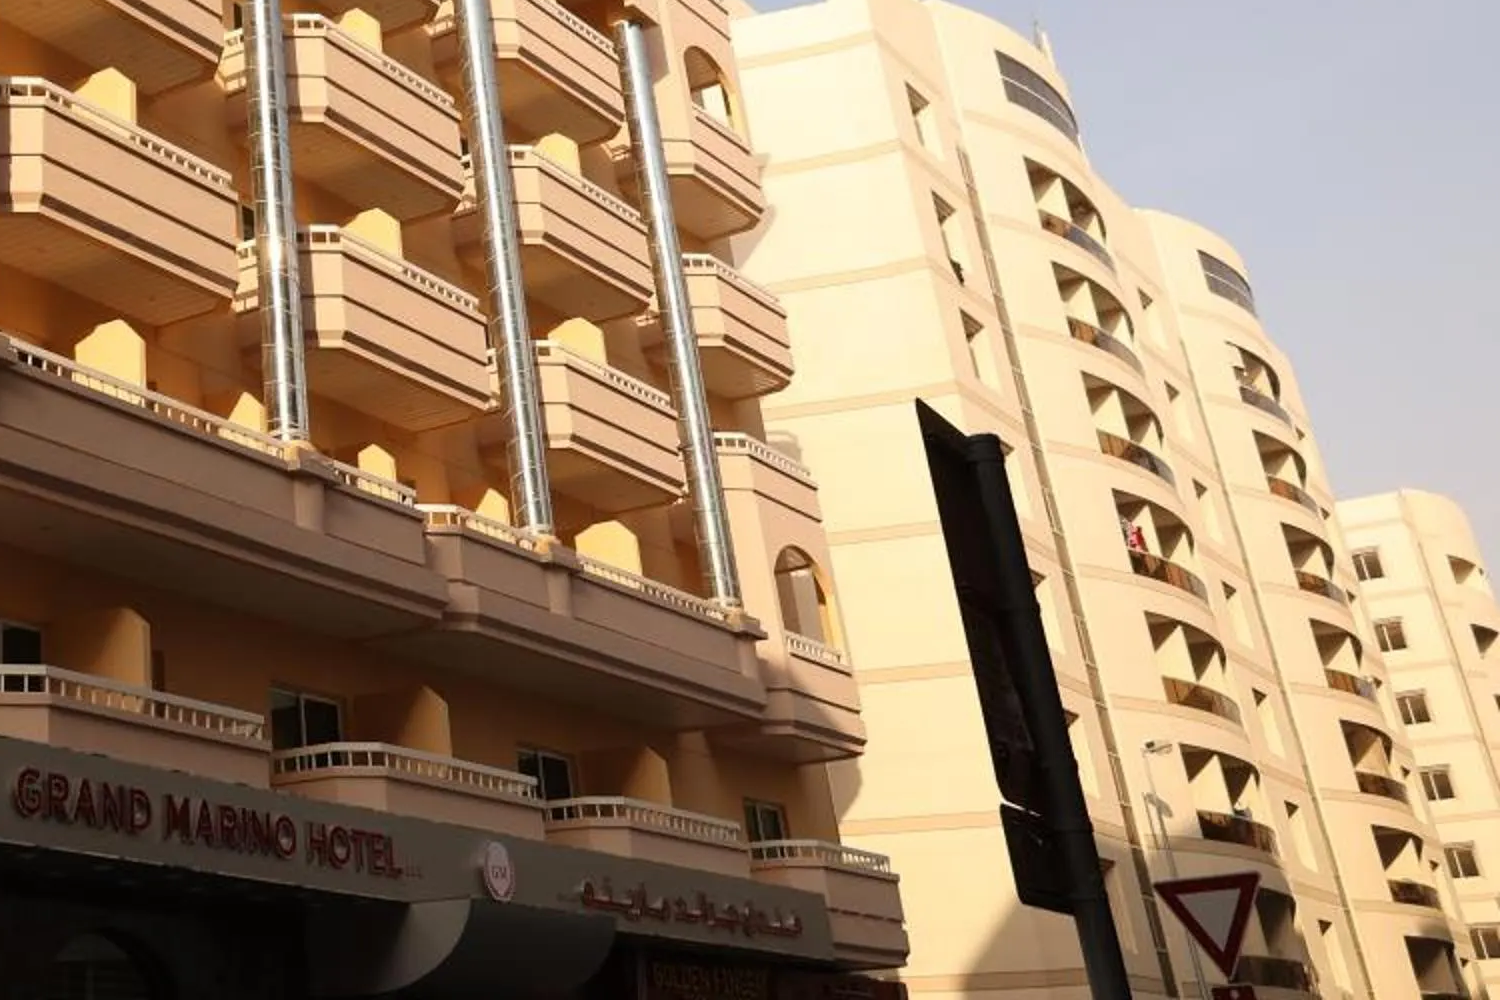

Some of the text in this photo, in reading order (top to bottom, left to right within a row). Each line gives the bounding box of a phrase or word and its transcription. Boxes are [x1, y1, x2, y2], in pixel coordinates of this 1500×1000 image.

[15, 768, 403, 880] GRAND MARINO HOTEL
